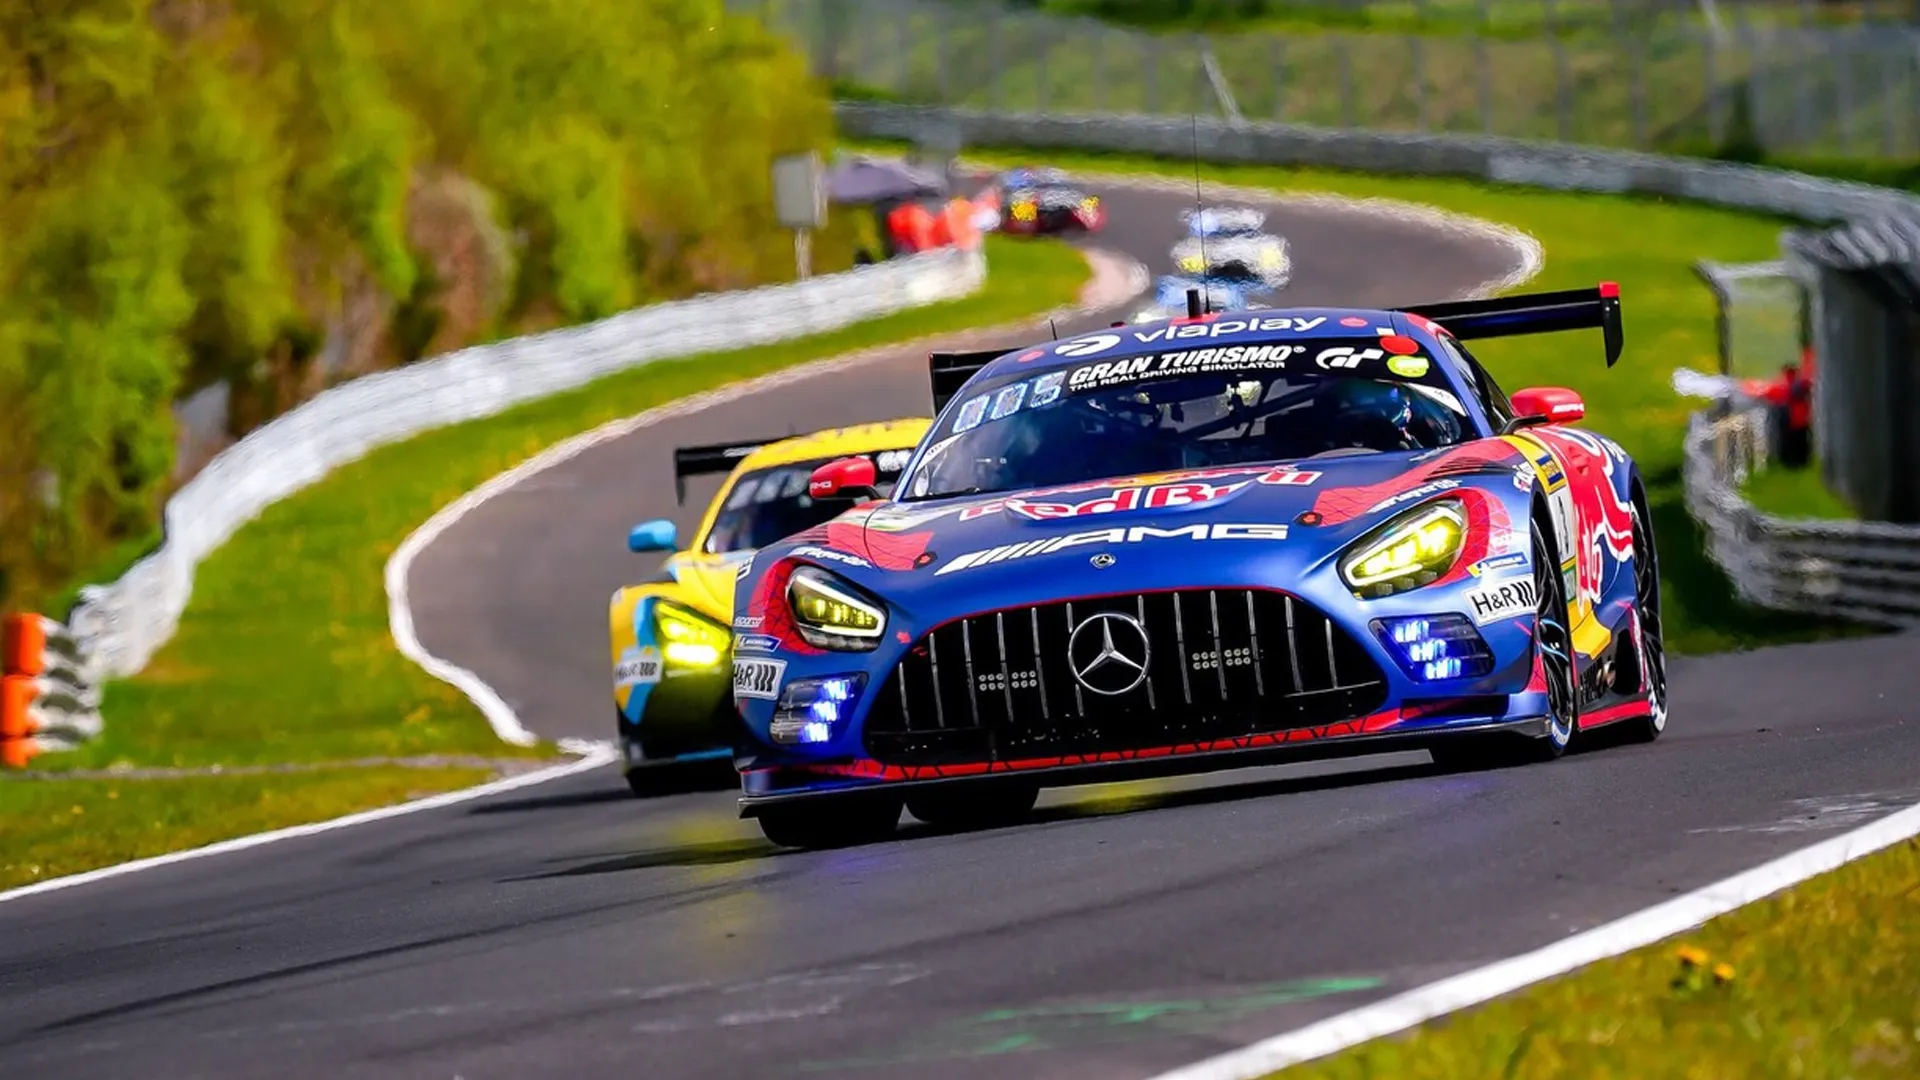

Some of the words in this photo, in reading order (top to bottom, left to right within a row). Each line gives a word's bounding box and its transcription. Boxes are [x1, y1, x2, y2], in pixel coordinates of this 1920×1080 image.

[1134, 317, 1326, 343] viaplay
[1069, 356, 1154, 385] GRAN
[1069, 381, 1097, 392] THE
[1100, 374, 1136, 386] REAL
[1139, 366, 1198, 379] DRIVING
[1201, 361, 1286, 372] SIMULATOR
[1471, 586, 1518, 616] H&R
